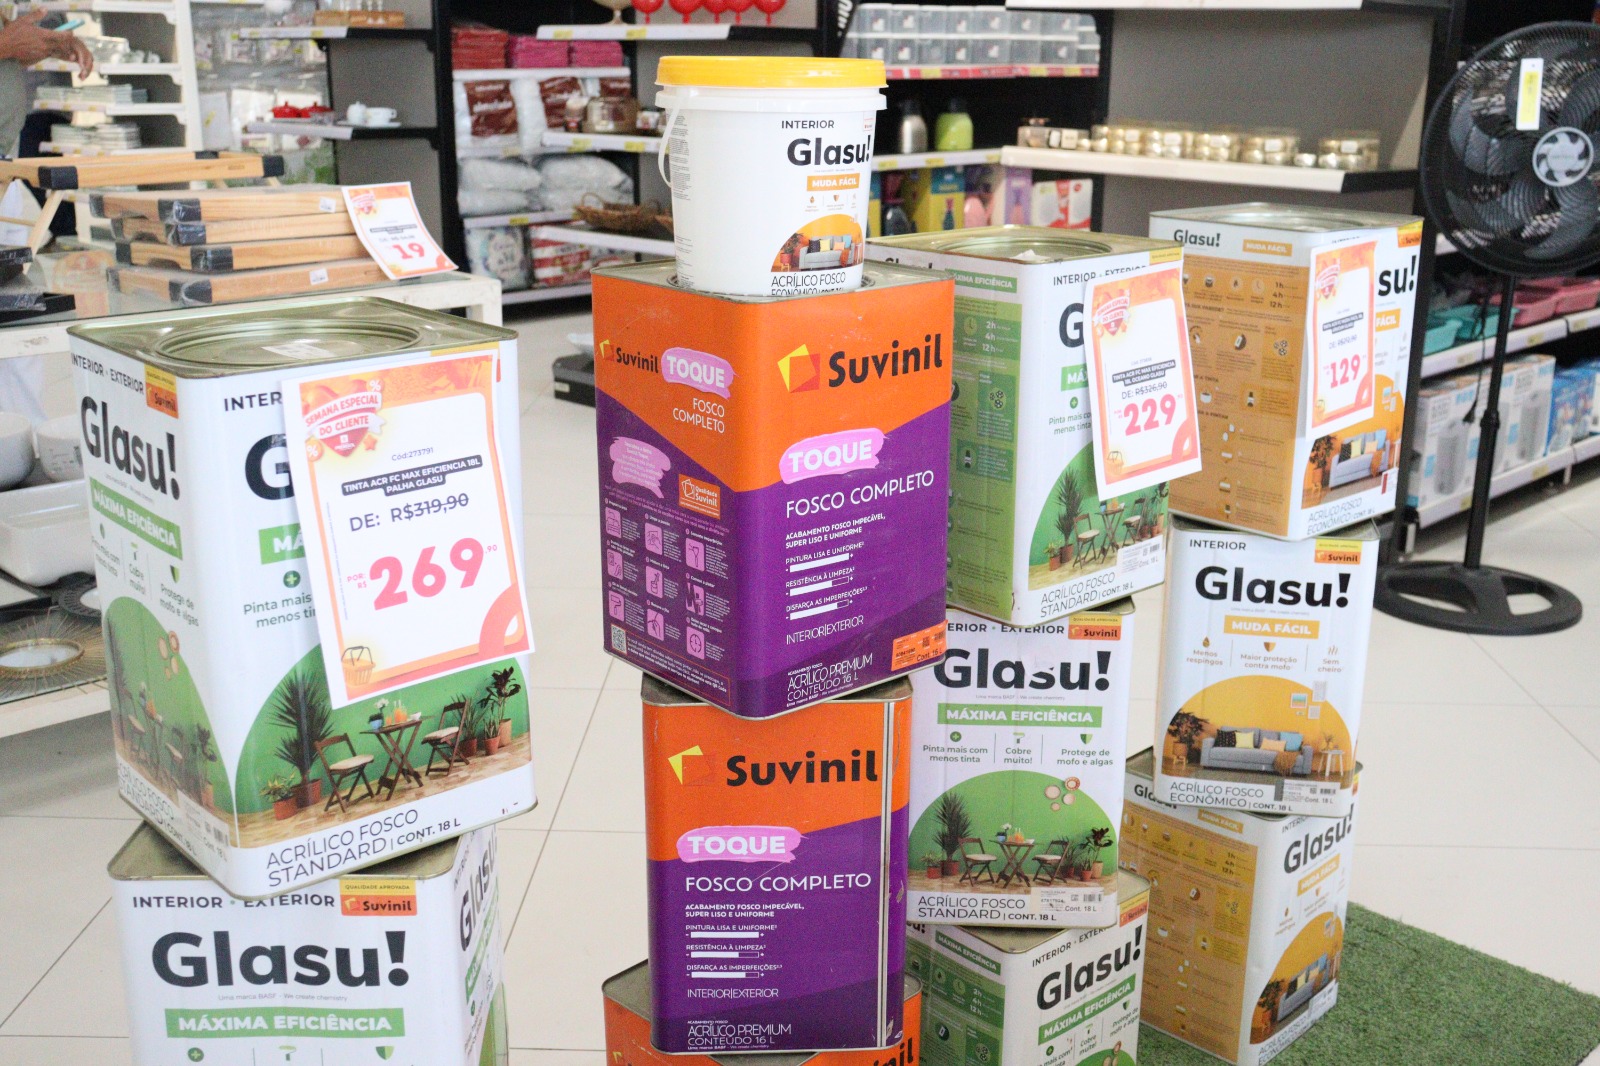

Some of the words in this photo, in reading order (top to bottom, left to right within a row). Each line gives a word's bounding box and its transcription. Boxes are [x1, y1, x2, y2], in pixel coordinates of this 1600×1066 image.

[782, 120, 834, 129] INTERIOR
[787, 134, 871, 166] Glasu!
[812, 179, 837, 188] MUDA
[839, 177, 857, 186] FÁCIL
[1173, 229, 1221, 248] Glasu!
[392, 242, 426, 260] 19
[771, 272, 818, 289] ACRÍLICO
[820, 271, 846, 286] FOSCO
[974, 276, 1012, 289] EFICIÊNCIA
[1054, 272, 1096, 286] INTERIOR
[616, 347, 658, 374] Suvinil
[828, 333, 943, 388] Suvinil
[71, 352, 104, 378] INTERIOR
[110, 368, 144, 396] EXTERIOR
[666, 355, 725, 388] TOQUE
[1330, 354, 1361, 388] 129
[1122, 390, 1134, 400] DE:
[305, 403, 339, 427] SEMANA
[340, 395, 379, 410] ESPECIAL
[693, 397, 725, 418] FOSCO
[1124, 393, 1176, 436] 229
[320, 426, 332, 436] DO
[335, 415, 369, 431] CLIENTE
[672, 408, 725, 433] COMPLETO
[1049, 416, 1066, 426] Pinta
[1067, 413, 1082, 422] mais
[1054, 426, 1074, 436] menos
[80, 395, 180, 500] Glasu!
[788, 438, 873, 473] TOQUE
[344, 480, 369, 494] TINTA
[370, 478, 388, 488] ACR
[389, 474, 400, 484] FC
[402, 469, 422, 480] MAX
[422, 461, 466, 477] EFICIENCIA
[467, 458, 480, 467] 18L
[386, 483, 415, 494] PALHA
[416, 475, 443, 487] GLASU
[695, 493, 718, 507] Suvinil
[786, 491, 845, 518] FOSCO
[850, 470, 934, 505] COMPLETO
[349, 514, 381, 532] DE:
[391, 492, 470, 522] R$319,90
[1341, 498, 1362, 514] FOSCO
[93, 486, 125, 520] MÁXIMA
[128, 509, 178, 549] EFICIÊNCIA
[785, 526, 830, 540] ACABAMENTO
[831, 520, 851, 530] FOSCO
[852, 513, 886, 526] IMPECÁVEL,
[785, 537, 807, 549] SUPER
[808, 535, 823, 544] LISO
[829, 526, 862, 540] UNIFORME
[1189, 539, 1246, 550] INTERIOR
[786, 554, 812, 564] PINTURA
[813, 551, 826, 559] LISA
[1328, 553, 1358, 562] Suvinil
[369, 537, 485, 610] 269
[786, 576, 822, 588] RESISTÊNCIA
[1041, 580, 1085, 604] ACRÍLICO
[1085, 572, 1116, 590] FOSCO
[1195, 565, 1350, 608] Glasu!
[243, 601, 278, 616] Pinta
[281, 592, 312, 608] mais
[786, 600, 814, 613] DISFARÇA
[1040, 590, 1098, 618] STANDARD
[1102, 584, 1122, 598] CONT.
[256, 610, 300, 628] menos
[1231, 621, 1271, 633] MUDA
[1274, 622, 1311, 635] FÁCIL
[1084, 629, 1118, 638] Suvinil
[934, 648, 1112, 692] Glasu!
[1186, 657, 1223, 666] respingos
[1263, 656, 1298, 665] proteção
[788, 667, 828, 692] ACRÍLICO
[829, 652, 873, 678] PREMIUM
[787, 677, 840, 702] CONTEÚDO
[842, 674, 851, 684] 16
[946, 708, 1006, 721] MÁXIMA
[1012, 709, 1093, 723] EFICIÊNCIA
[923, 745, 945, 753] Pinta
[1061, 748, 1097, 758] Protege
[726, 749, 878, 787] Suvinil
[956, 755, 980, 763] tinta
[1004, 756, 1033, 764] muito!
[1057, 757, 1081, 766] mofo
[1089, 758, 1114, 767] algas
[1170, 781, 1222, 795] ACRÍLICO
[1225, 786, 1264, 798] FOSCO
[1170, 792, 1246, 808] ECONÔMICO
[266, 828, 354, 870] ACRÍLICO
[360, 809, 418, 840] FOSCO
[688, 836, 785, 856] TOQUE
[1284, 803, 1354, 874] Glasu!
[268, 836, 387, 888] STANDARD
[397, 825, 436, 846] CONT.
[438, 821, 452, 832] 18
[454, 818, 461, 828] L
[685, 876, 752, 892] FOSCO
[760, 873, 872, 892] COMPLETO
[132, 895, 223, 908] INTERIOR
[362, 899, 412, 912] Suvinil
[762, 902, 804, 910] IMPECÁVEL,
[918, 896, 978, 908] ACRÍLICO
[981, 898, 1025, 909] FOSCO
[918, 908, 1000, 919] STANDARD
[1008, 913, 1036, 921] CONT.
[151, 930, 410, 988] Glasu!
[962, 947, 997, 971] EFICIÊNCIA
[1032, 942, 1071, 967] INTERIOR
[1036, 924, 1143, 1010] Glasu!
[1044, 1011, 1084, 1039] MÁXIMA
[1084, 982, 1132, 1016] EFICIÊNCIA
[178, 1014, 268, 1032] MÁXIMA
[274, 1012, 392, 1032] EFICIÊNCIA
[688, 1023, 736, 1037] ACRÍLICO
[737, 1024, 792, 1036] PREMIUM
[688, 1035, 752, 1046] CONTEÚDO
